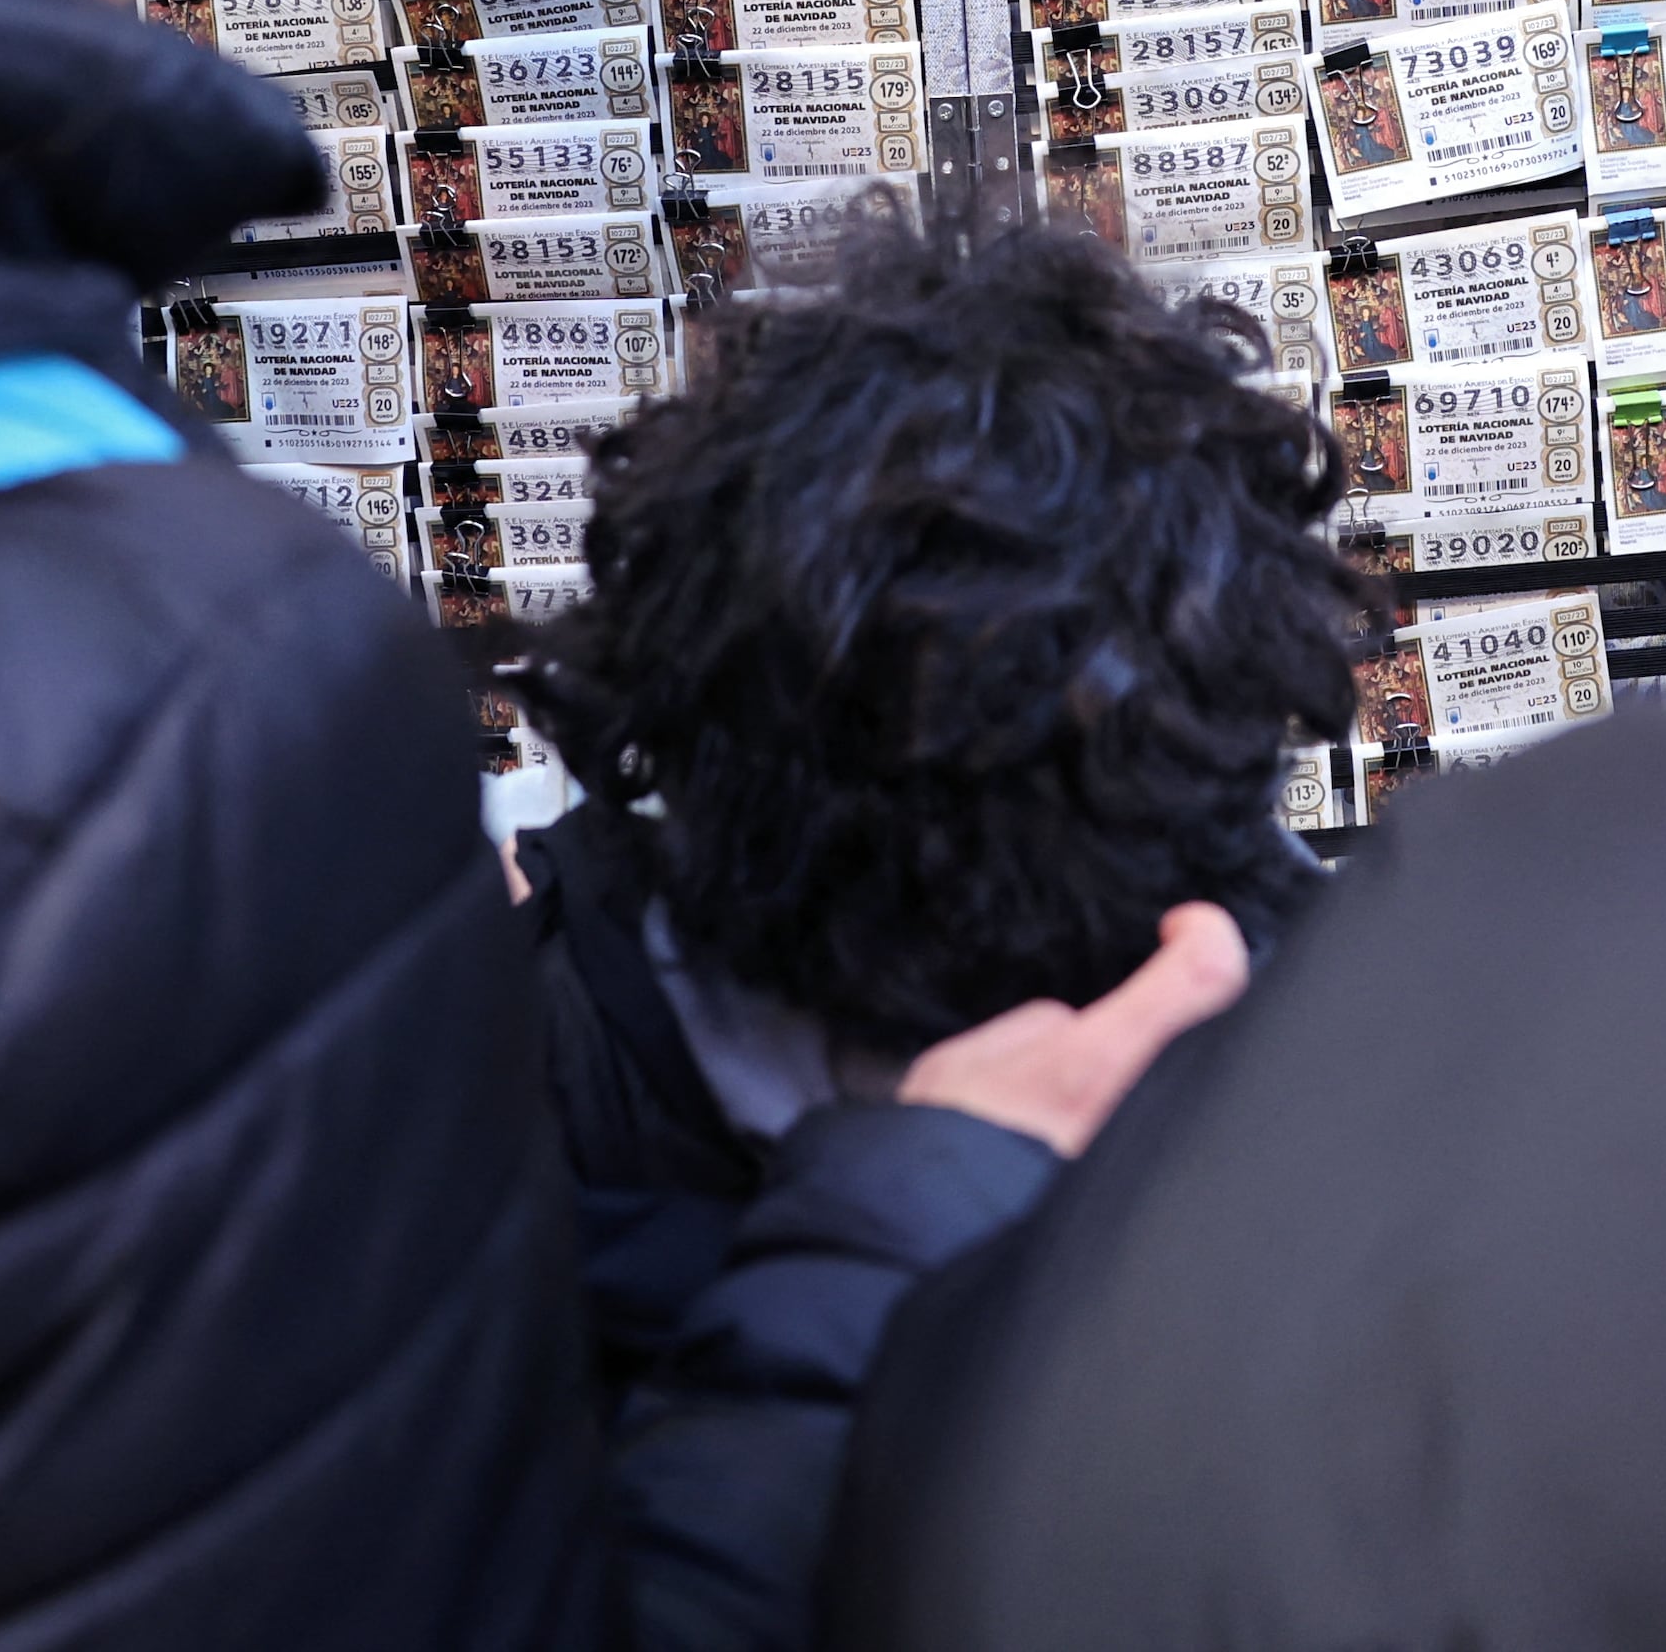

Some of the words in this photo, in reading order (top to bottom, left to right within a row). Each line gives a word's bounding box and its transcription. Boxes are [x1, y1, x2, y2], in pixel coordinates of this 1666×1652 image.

[224, 18, 270, 30] LOTERÍA
[274, 17, 328, 27] NACIONAL
[244, 32, 258, 40] DE
[262, 29, 311, 39] NAVIDAD
[1134, 29, 1245, 61] 28157
[1404, 35, 1517, 78] 73039
[488, 55, 595, 83] 36723
[754, 69, 863, 94] 28155
[753, 102, 803, 113] LOTERÍA
[806, 103, 866, 112] NACIONAL
[1141, 81, 1251, 114] 33067
[774, 116, 789, 124] DE
[793, 115, 846, 124] NAVIDAD
[786, 127, 826, 136] diciembre
[488, 146, 593, 169] 55133
[1135, 145, 1247, 174] 88587
[488, 178, 537, 189] LOTERÍA
[540, 177, 598, 187] NACIONAL
[1134, 182, 1185, 196] LOTERÍA
[1189, 178, 1250, 191] NACIONAL
[528, 189, 579, 199] NAVIDAD
[1156, 197, 1171, 205] DE
[1175, 191, 1230, 204] NAVIDAD
[491, 238, 598, 260] 28153
[1412, 244, 1524, 278] 43069
[254, 323, 352, 344] 19271
[503, 324, 609, 344] 48663
[252, 354, 298, 363] LOTERÍA
[301, 355, 356, 363] NACIONAL
[288, 366, 337, 375] NAVIDAD
[1416, 386, 1530, 414] 69710
[1418, 420, 1469, 433] LOTERÍA
[1472, 418, 1533, 429] NACIONAL
[1439, 435, 1454, 443] DE
[1458, 430, 1513, 442] NAVIDAD
[1426, 533, 1538, 560] 39020
[1433, 626, 1546, 662] 41040
